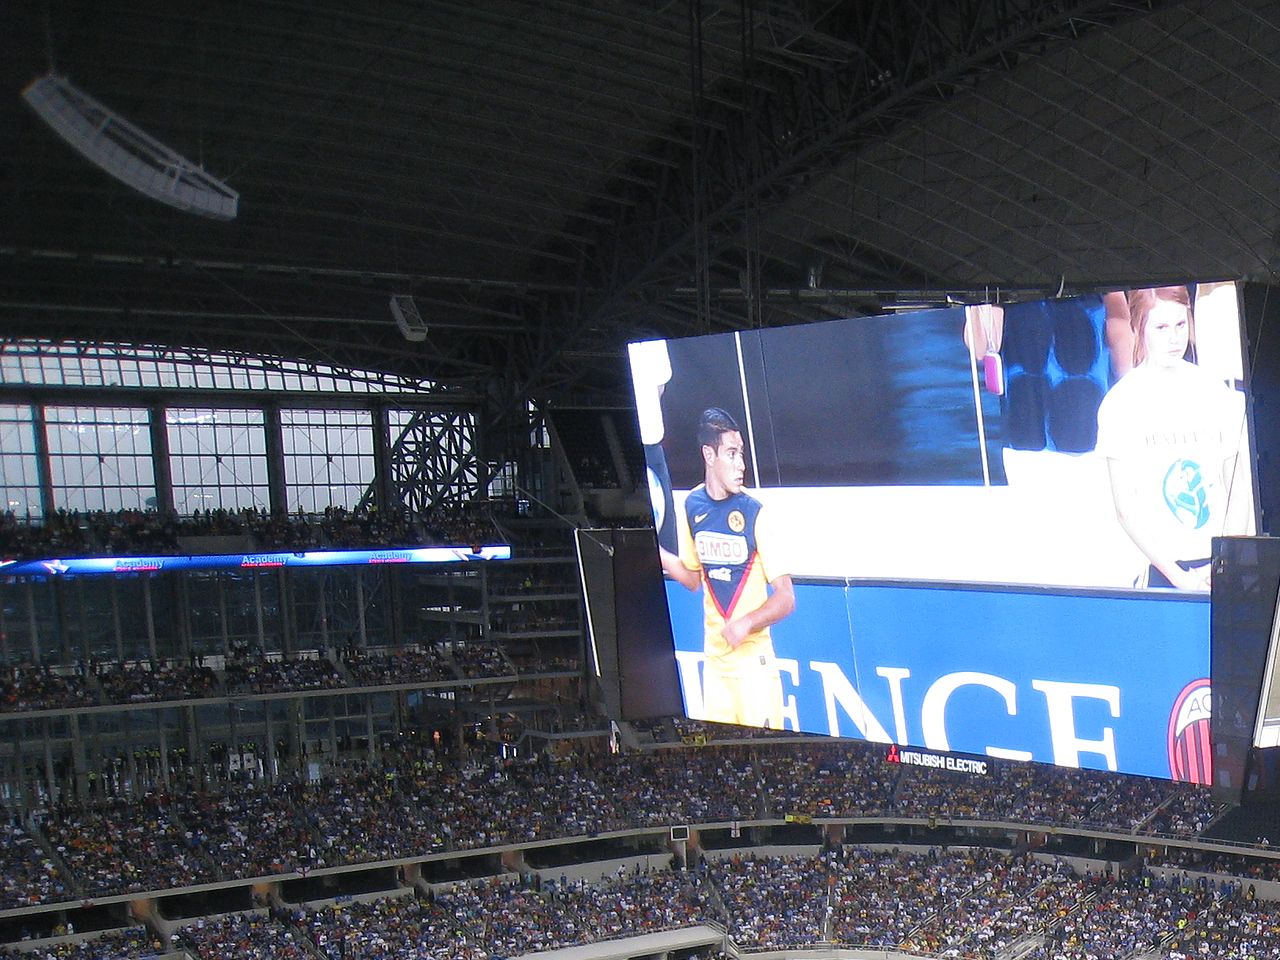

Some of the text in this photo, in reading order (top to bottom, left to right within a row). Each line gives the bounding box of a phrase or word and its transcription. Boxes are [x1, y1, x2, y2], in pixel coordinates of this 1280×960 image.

[241, 555, 287, 566] Academy
[900, 750, 987, 775] MITSUBISHI ELECTRIC
